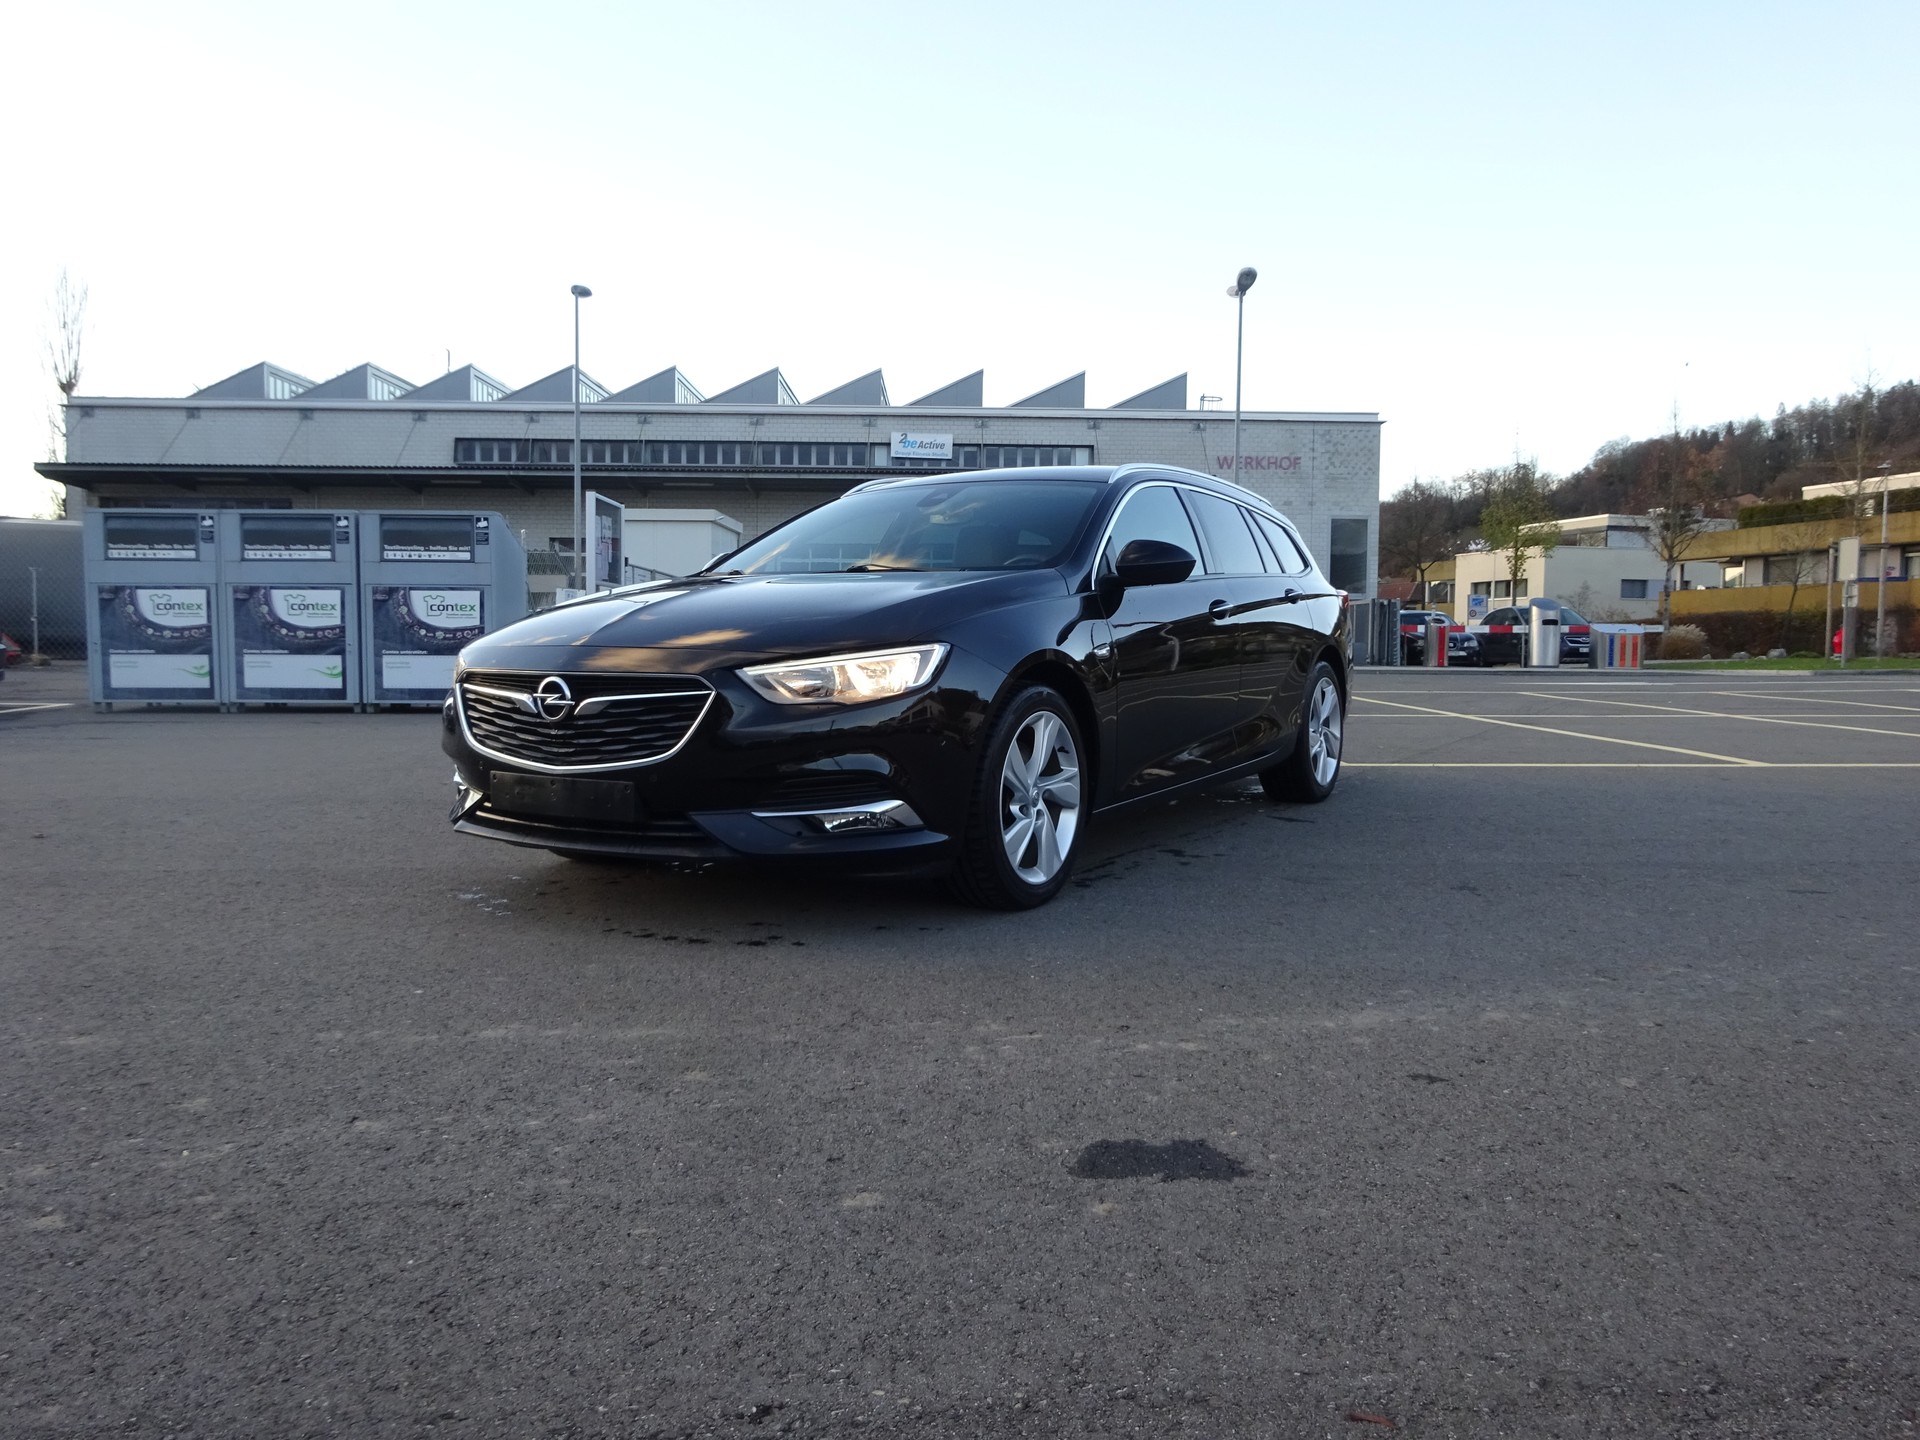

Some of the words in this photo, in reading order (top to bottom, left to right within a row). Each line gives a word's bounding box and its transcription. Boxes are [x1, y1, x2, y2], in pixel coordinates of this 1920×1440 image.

[918, 440, 945, 449] Active
[156, 602, 203, 611] contex
[290, 602, 337, 611] contex
[430, 603, 476, 612] contex
